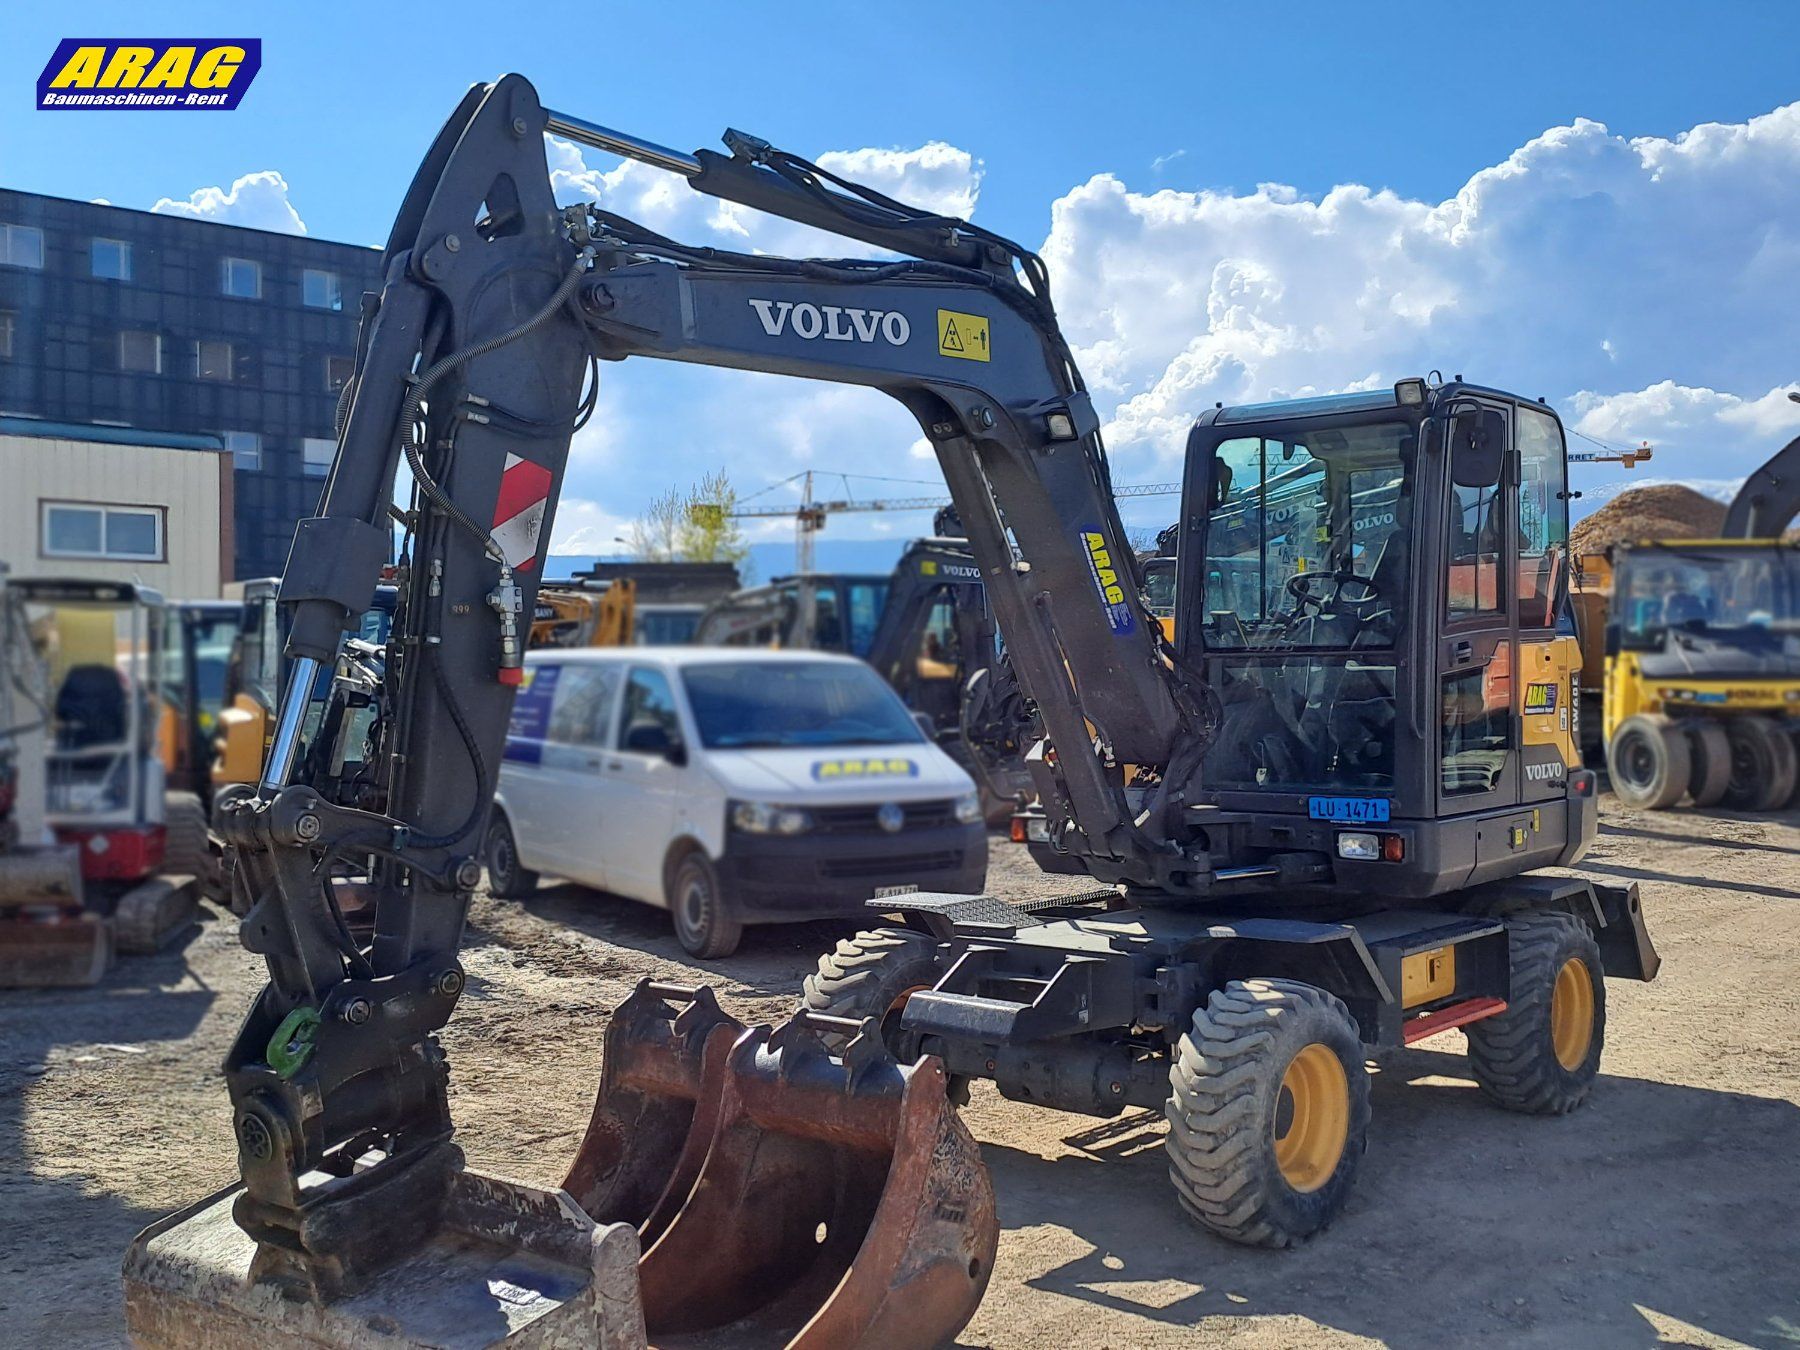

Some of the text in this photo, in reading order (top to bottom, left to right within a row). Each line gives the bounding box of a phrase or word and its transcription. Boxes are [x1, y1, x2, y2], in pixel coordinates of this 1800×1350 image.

[748, 298, 911, 346] VOLVO
[1353, 512, 1395, 532] OLVO
[942, 564, 981, 578] VOLVO
[1085, 531, 1125, 606] ARAG
[1526, 685, 1548, 706] ARAG
[1571, 677, 1579, 732] EW60E
[1525, 762, 1562, 781] VOLVO
